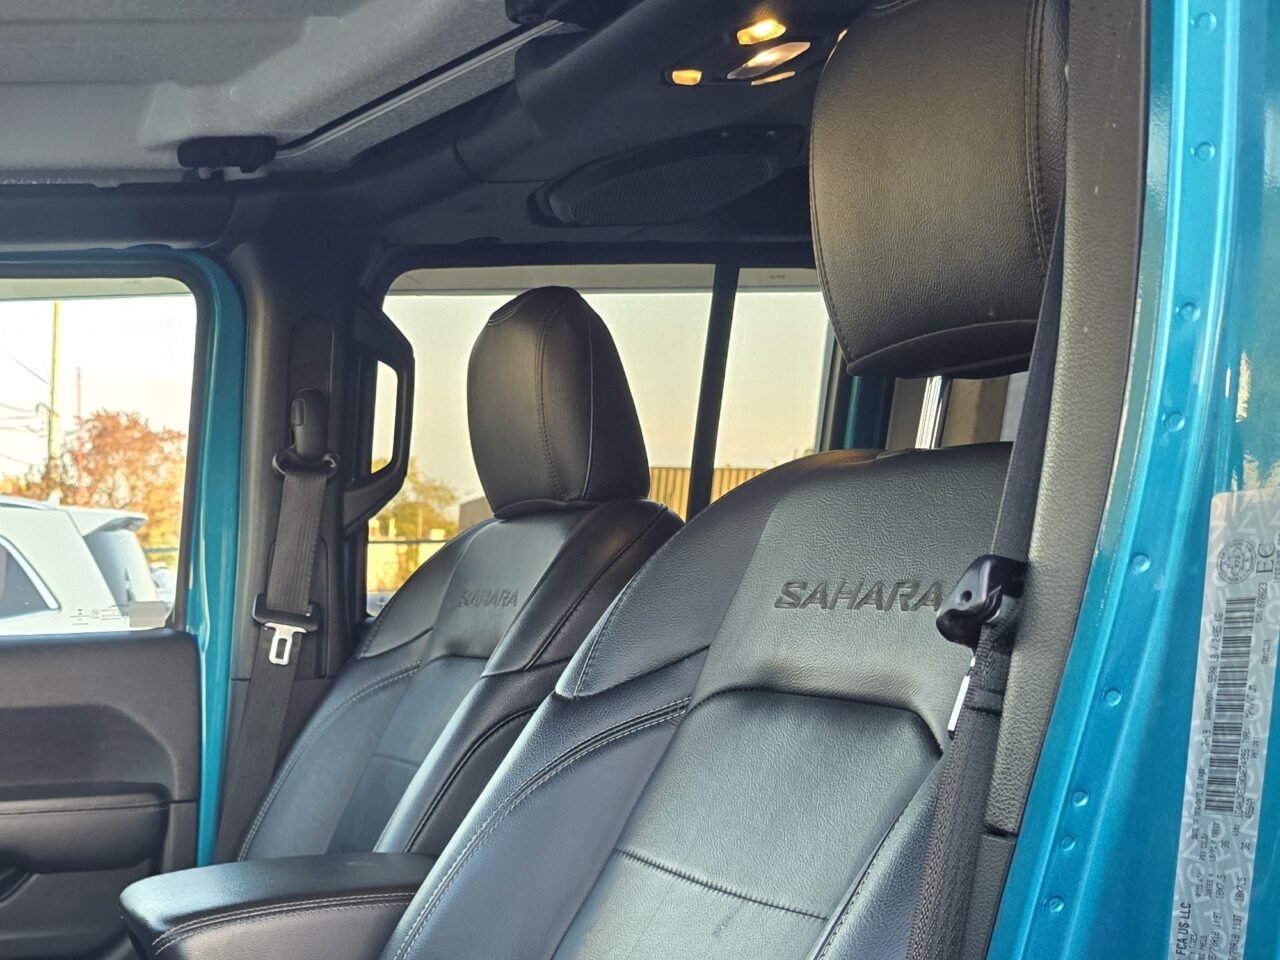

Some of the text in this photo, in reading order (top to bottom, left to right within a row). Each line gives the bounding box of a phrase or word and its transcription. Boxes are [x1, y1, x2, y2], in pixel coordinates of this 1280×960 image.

[460, 588, 518, 609] SAHARA
[773, 580, 945, 612] SAHARA
[1178, 901, 1191, 919] LLC
[1177, 920, 1189, 935] US
[1175, 936, 1188, 956] FCA
